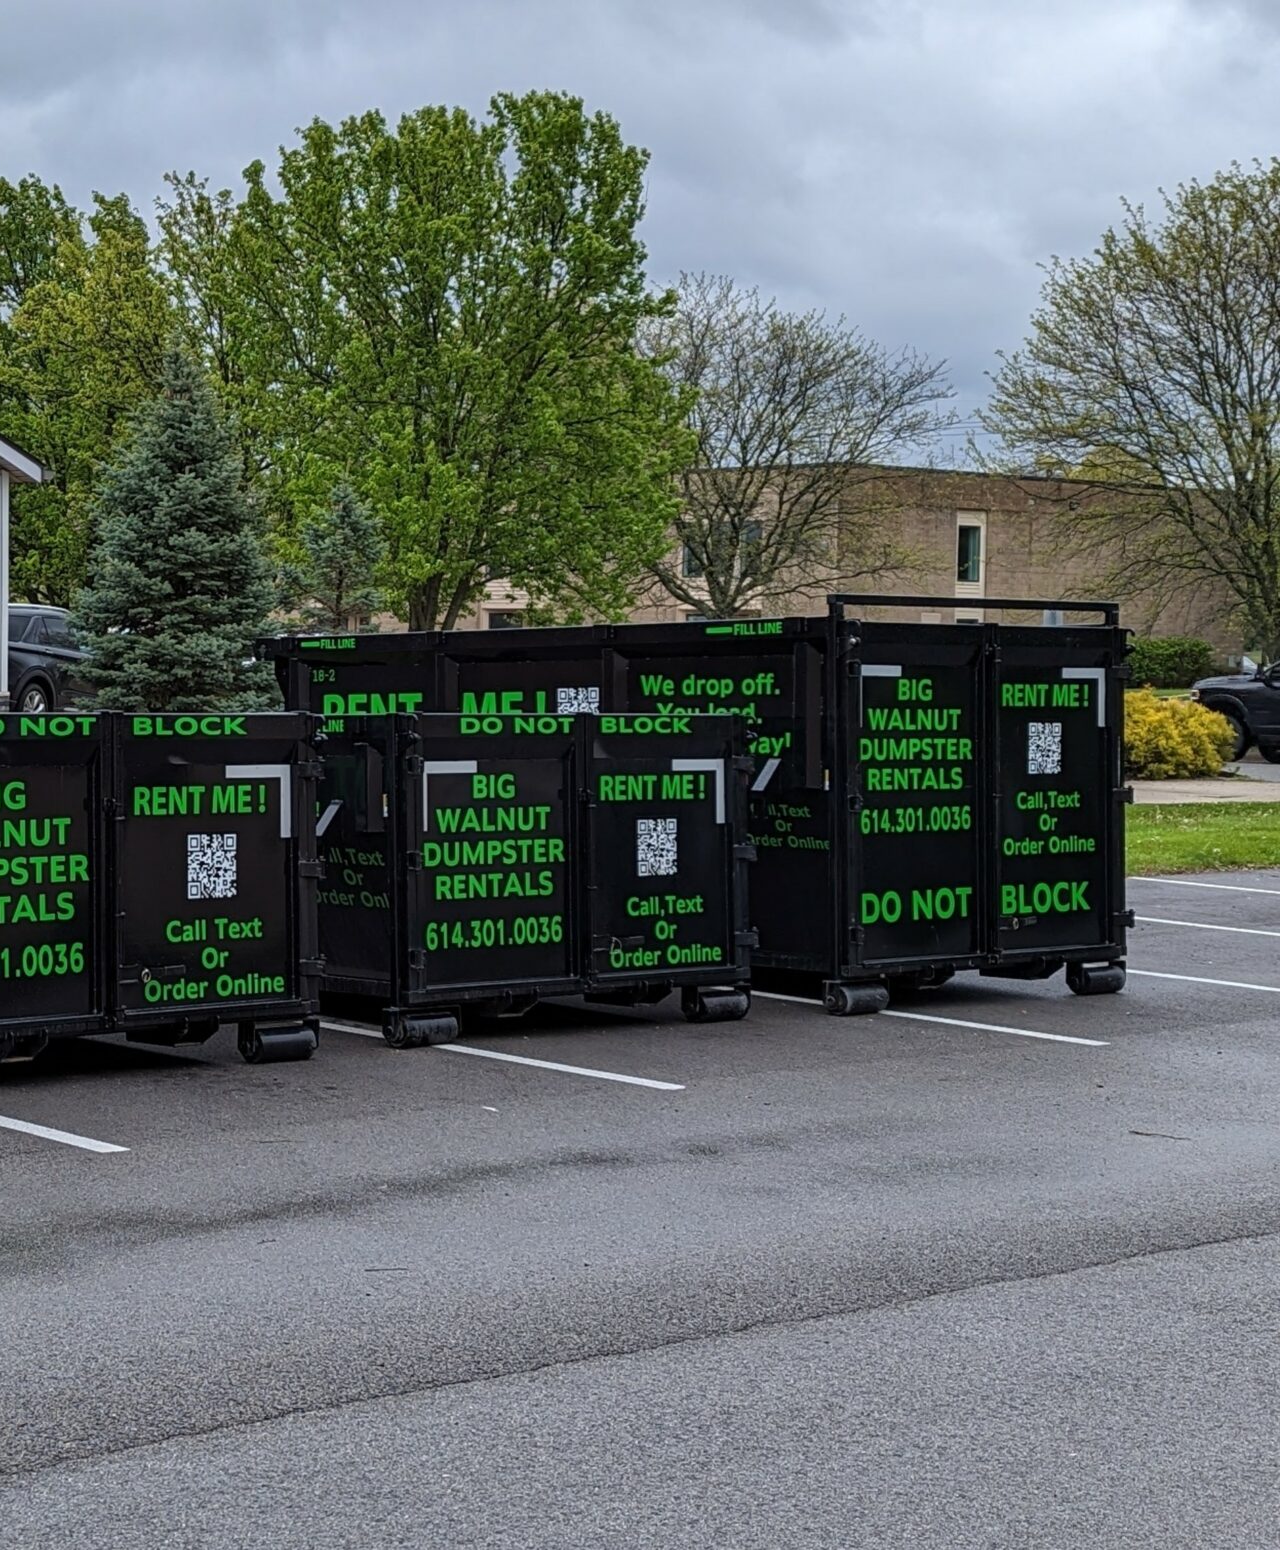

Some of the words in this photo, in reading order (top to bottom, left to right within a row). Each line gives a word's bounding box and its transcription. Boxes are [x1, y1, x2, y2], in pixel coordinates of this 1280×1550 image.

[733, 623, 756, 636] FILL
[757, 622, 782, 635] LINE
[320, 637, 337, 651] FILL
[338, 637, 357, 650] LINE
[640, 676, 675, 697] We
[681, 675, 734, 698] drop
[741, 672, 781, 696] off.
[896, 678, 933, 702] BIG
[1001, 683, 1049, 707] RENT
[20, 716, 96, 737] NOT
[132, 716, 245, 736] BLOCK
[459, 717, 504, 735] DO
[512, 717, 573, 735] NOT
[600, 716, 690, 734] BLOCK
[867, 708, 960, 732] WALNUT
[859, 737, 972, 762] DUMPSTER
[471, 773, 516, 800] BIG
[599, 774, 656, 801] RENT
[865, 767, 963, 792] RENTALS
[133, 785, 206, 816] RENT
[1015, 790, 1080, 812] Call,Text
[435, 805, 550, 832] WALNUT
[775, 819, 793, 832] Or
[859, 805, 971, 835] 614.301.0036
[1037, 813, 1057, 832] Or
[422, 838, 564, 868] DUMPSTER
[1002, 837, 1045, 856] Order
[1047, 835, 1095, 854] Online
[343, 867, 365, 887] Or
[435, 870, 554, 900] RENTALS
[626, 895, 702, 917] Call,Text
[860, 890, 902, 924] DO
[911, 886, 971, 920] NOT
[1000, 881, 1088, 916] BLOCK
[425, 914, 563, 951] 614.301.0036
[653, 918, 676, 941] Or
[200, 946, 229, 970] Or
[610, 949, 660, 968] Order
[665, 944, 721, 965] Online
[144, 980, 208, 1003] Order
[214, 973, 284, 997] Online
